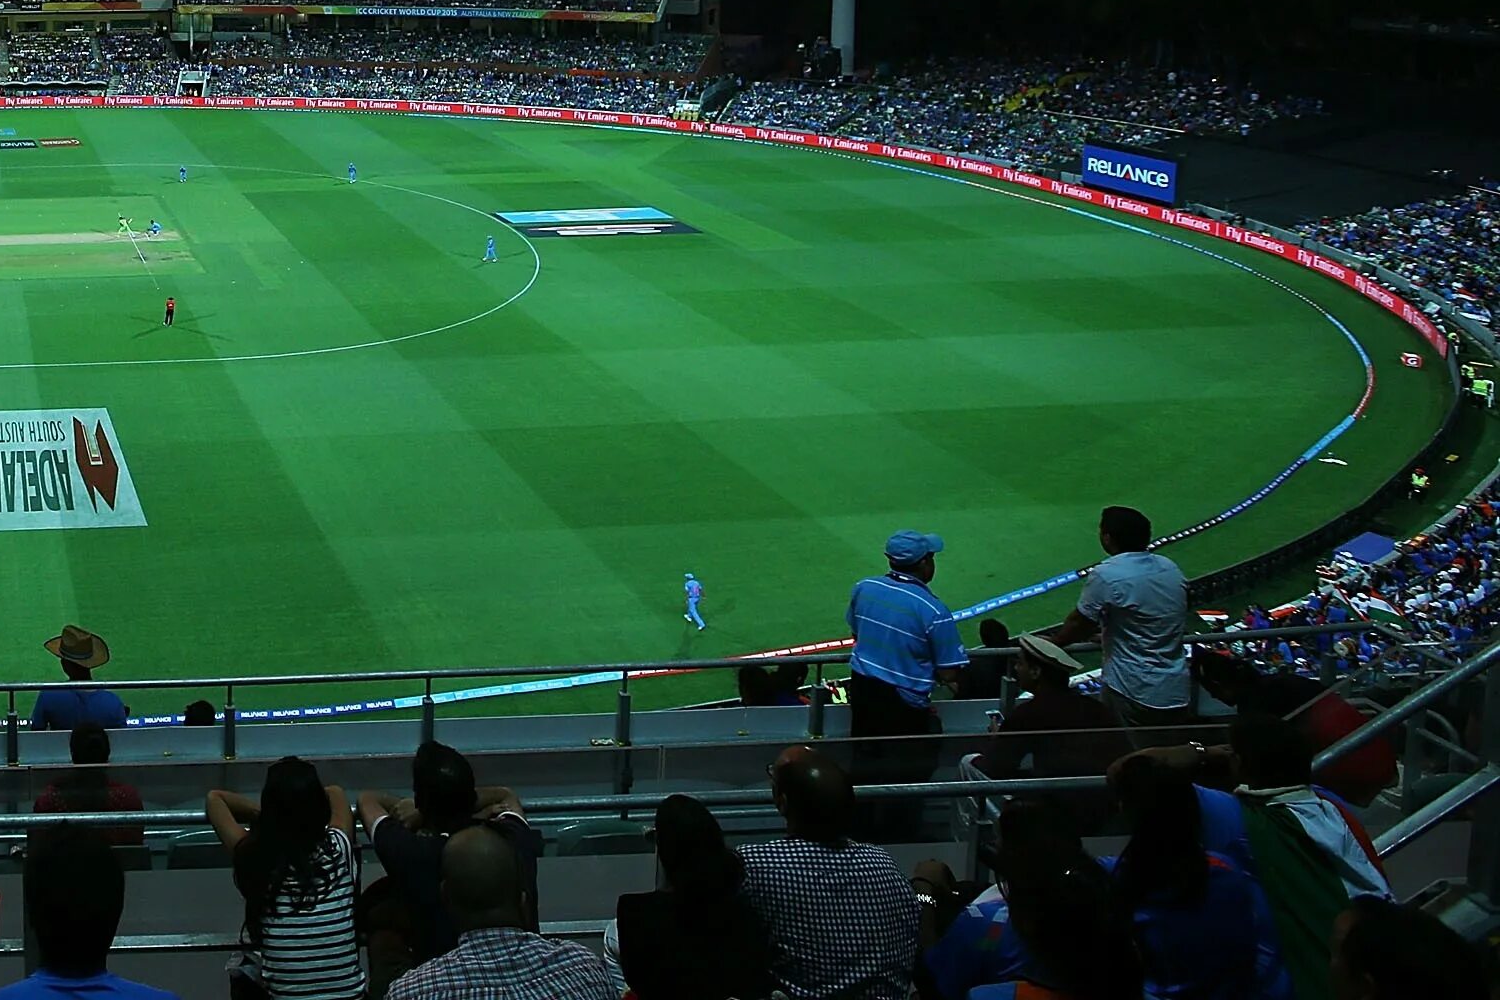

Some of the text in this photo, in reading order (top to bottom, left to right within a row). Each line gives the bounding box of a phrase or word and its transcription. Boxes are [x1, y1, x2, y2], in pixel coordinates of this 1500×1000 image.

[5, 98, 16, 107] Fly
[54, 97, 64, 105] Fly
[104, 97, 115, 105] Fly
[153, 97, 164, 105] Fly
[204, 98, 215, 106] Fly
[254, 98, 266, 106] Fly
[305, 99, 316, 108] Fly
[356, 101, 368, 109] Fly
[409, 103, 420, 111] Fly
[462, 106, 505, 114] Fly Emirates
[517, 108, 561, 117] Fly Emirates
[573, 111, 618, 121] Fly Emirates
[631, 115, 677, 128] Fly Emirates
[690, 122, 742, 135] Fly Emirates
[756, 129, 804, 142] Fly Emirates
[818, 137, 868, 151] Fly Emirates
[882, 146, 931, 161] Fly Emirates
[945, 157, 991, 174] Fly Emirates
[1003, 169, 1041, 186] Fly Emirates
[1087, 157, 1169, 188] RELIANCE
[1051, 181, 1092, 199] Fly Emirates
[1103, 195, 1148, 214] Fly Emirates
[1161, 210, 1210, 230] Fly Emirates
[1225, 227, 1284, 253] Fly Emirates
[1297, 250, 1345, 279] Fly Emirates
[30, 421, 65, 442] SOUTH
